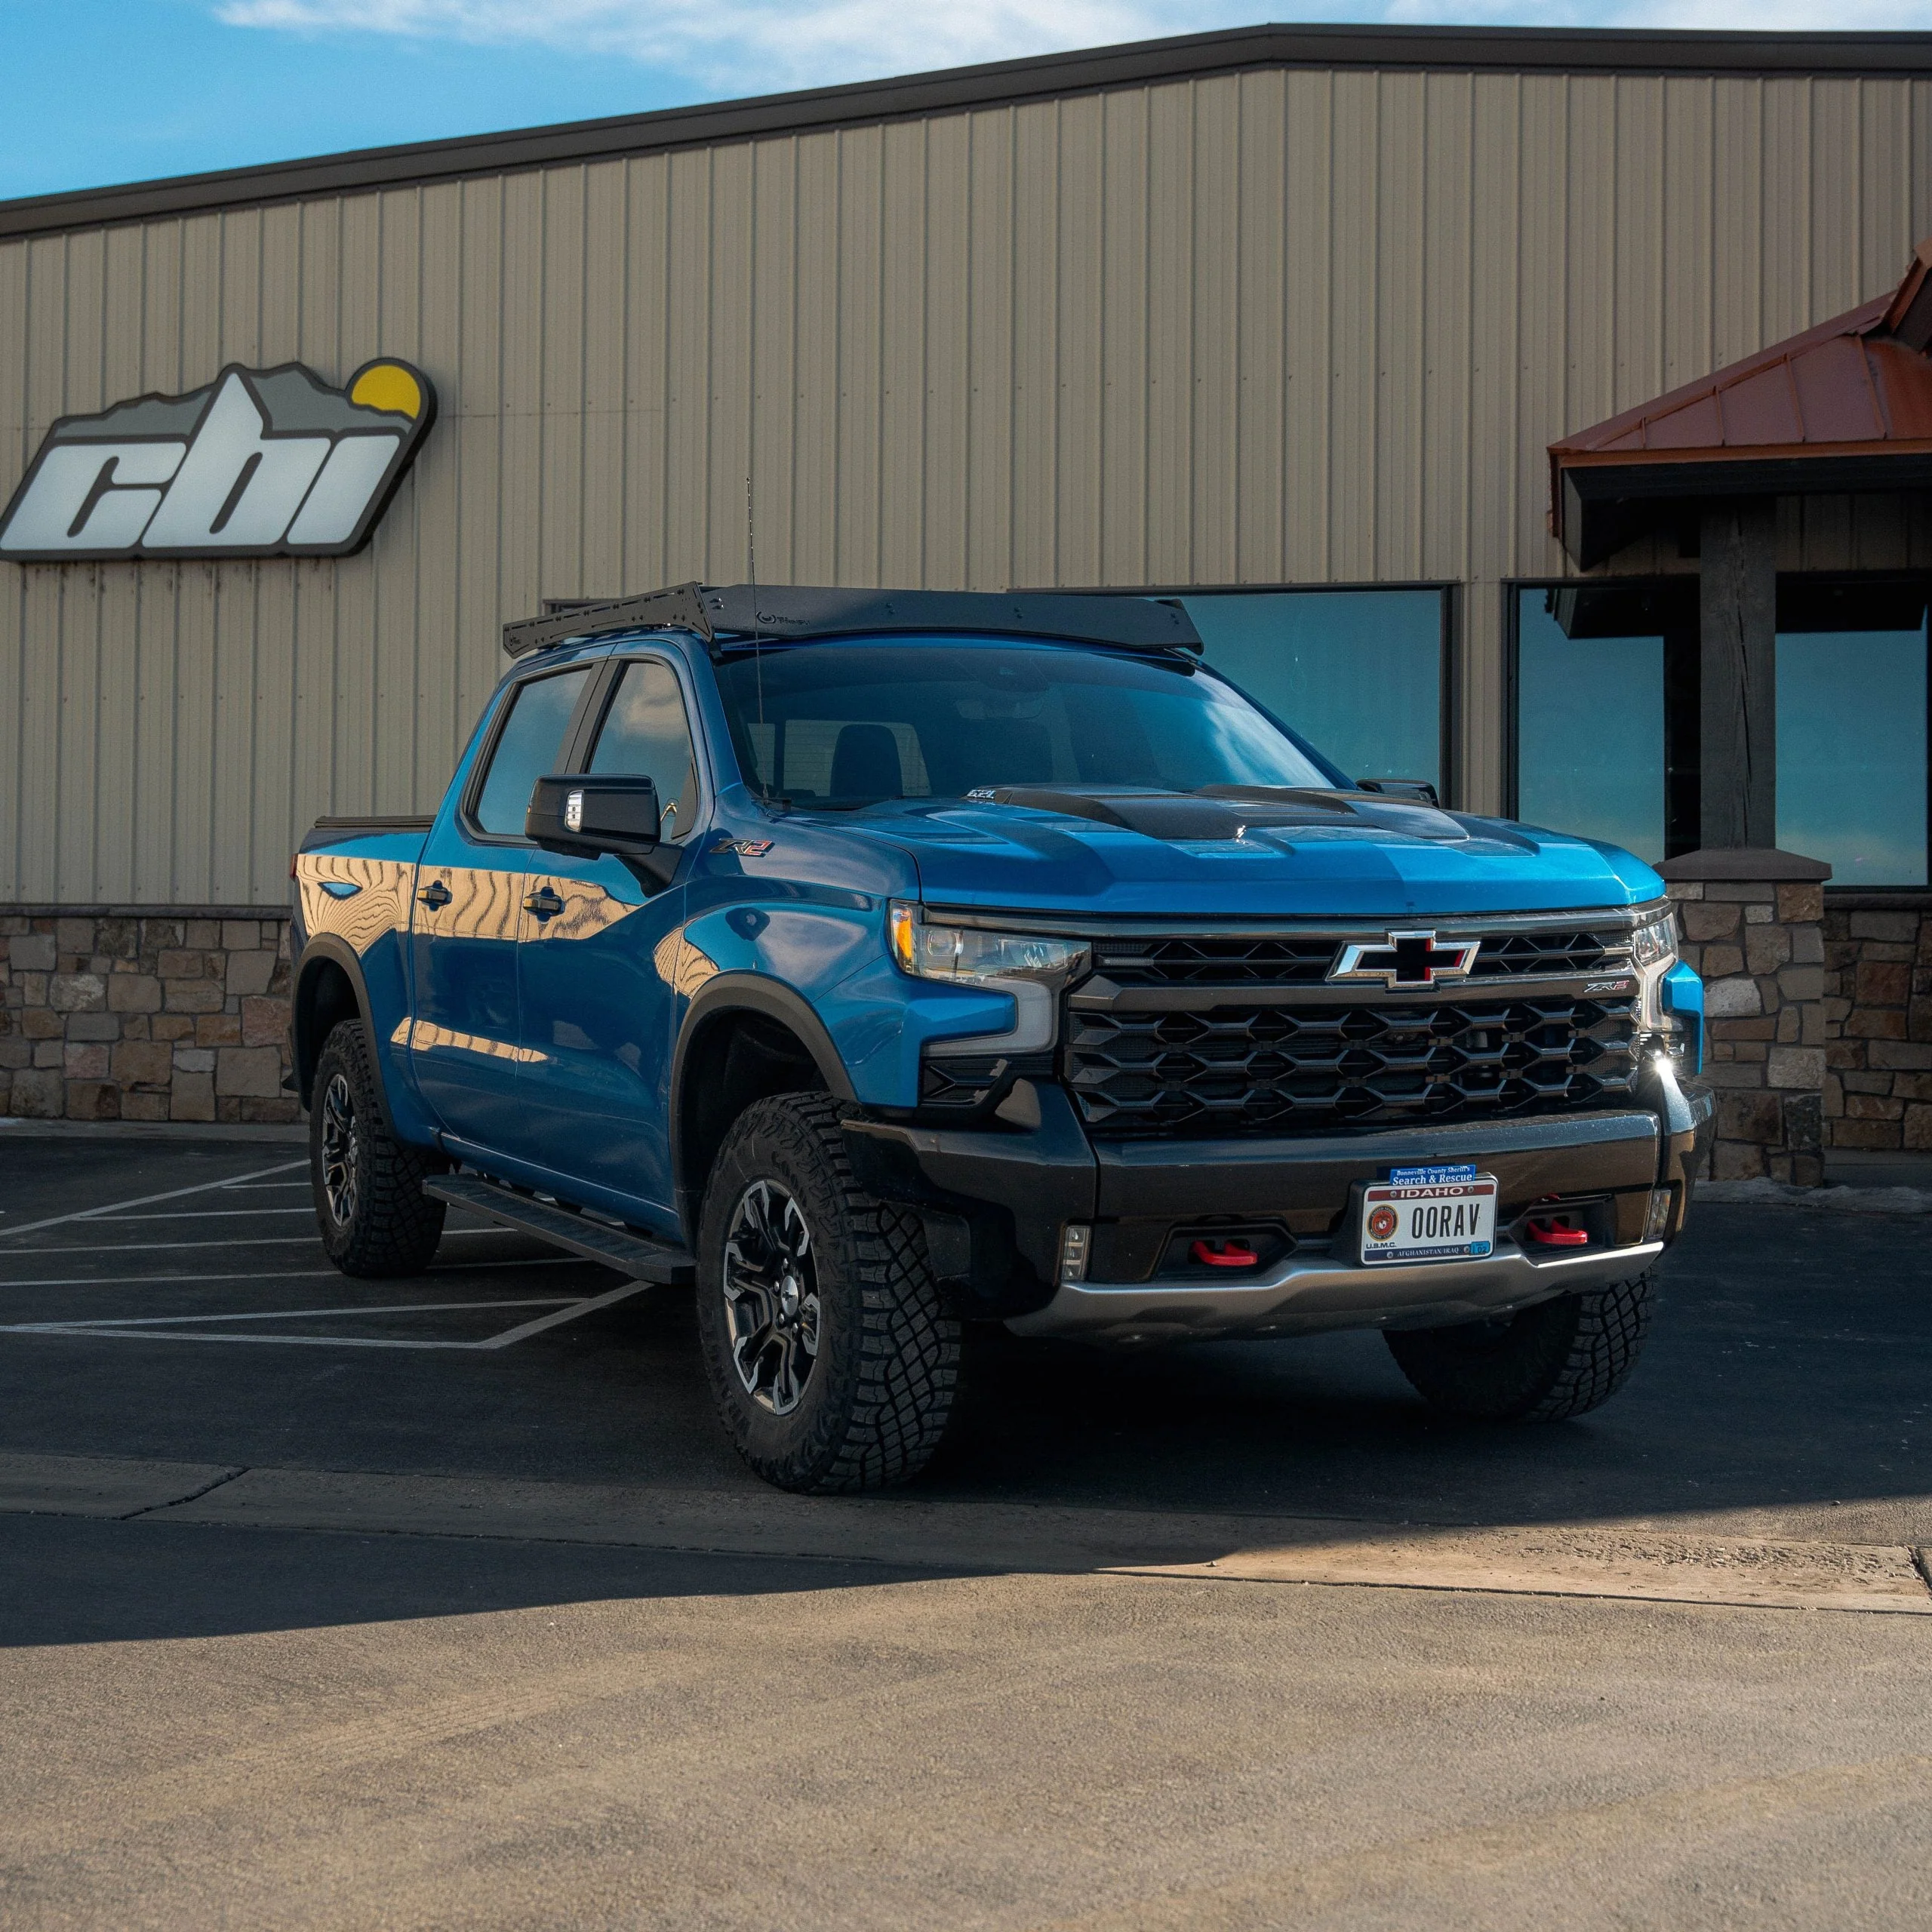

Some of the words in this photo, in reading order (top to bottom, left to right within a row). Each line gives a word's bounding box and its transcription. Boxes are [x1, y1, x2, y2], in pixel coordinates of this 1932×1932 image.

[709, 838, 774, 856] ZR2
[1583, 980, 1630, 992] ZR2
[1392, 1175, 1426, 1186] Search
[1429, 1174, 1436, 1183] &
[1438, 1174, 1472, 1183] Rescue
[1400, 1186, 1464, 1198] IDAHO
